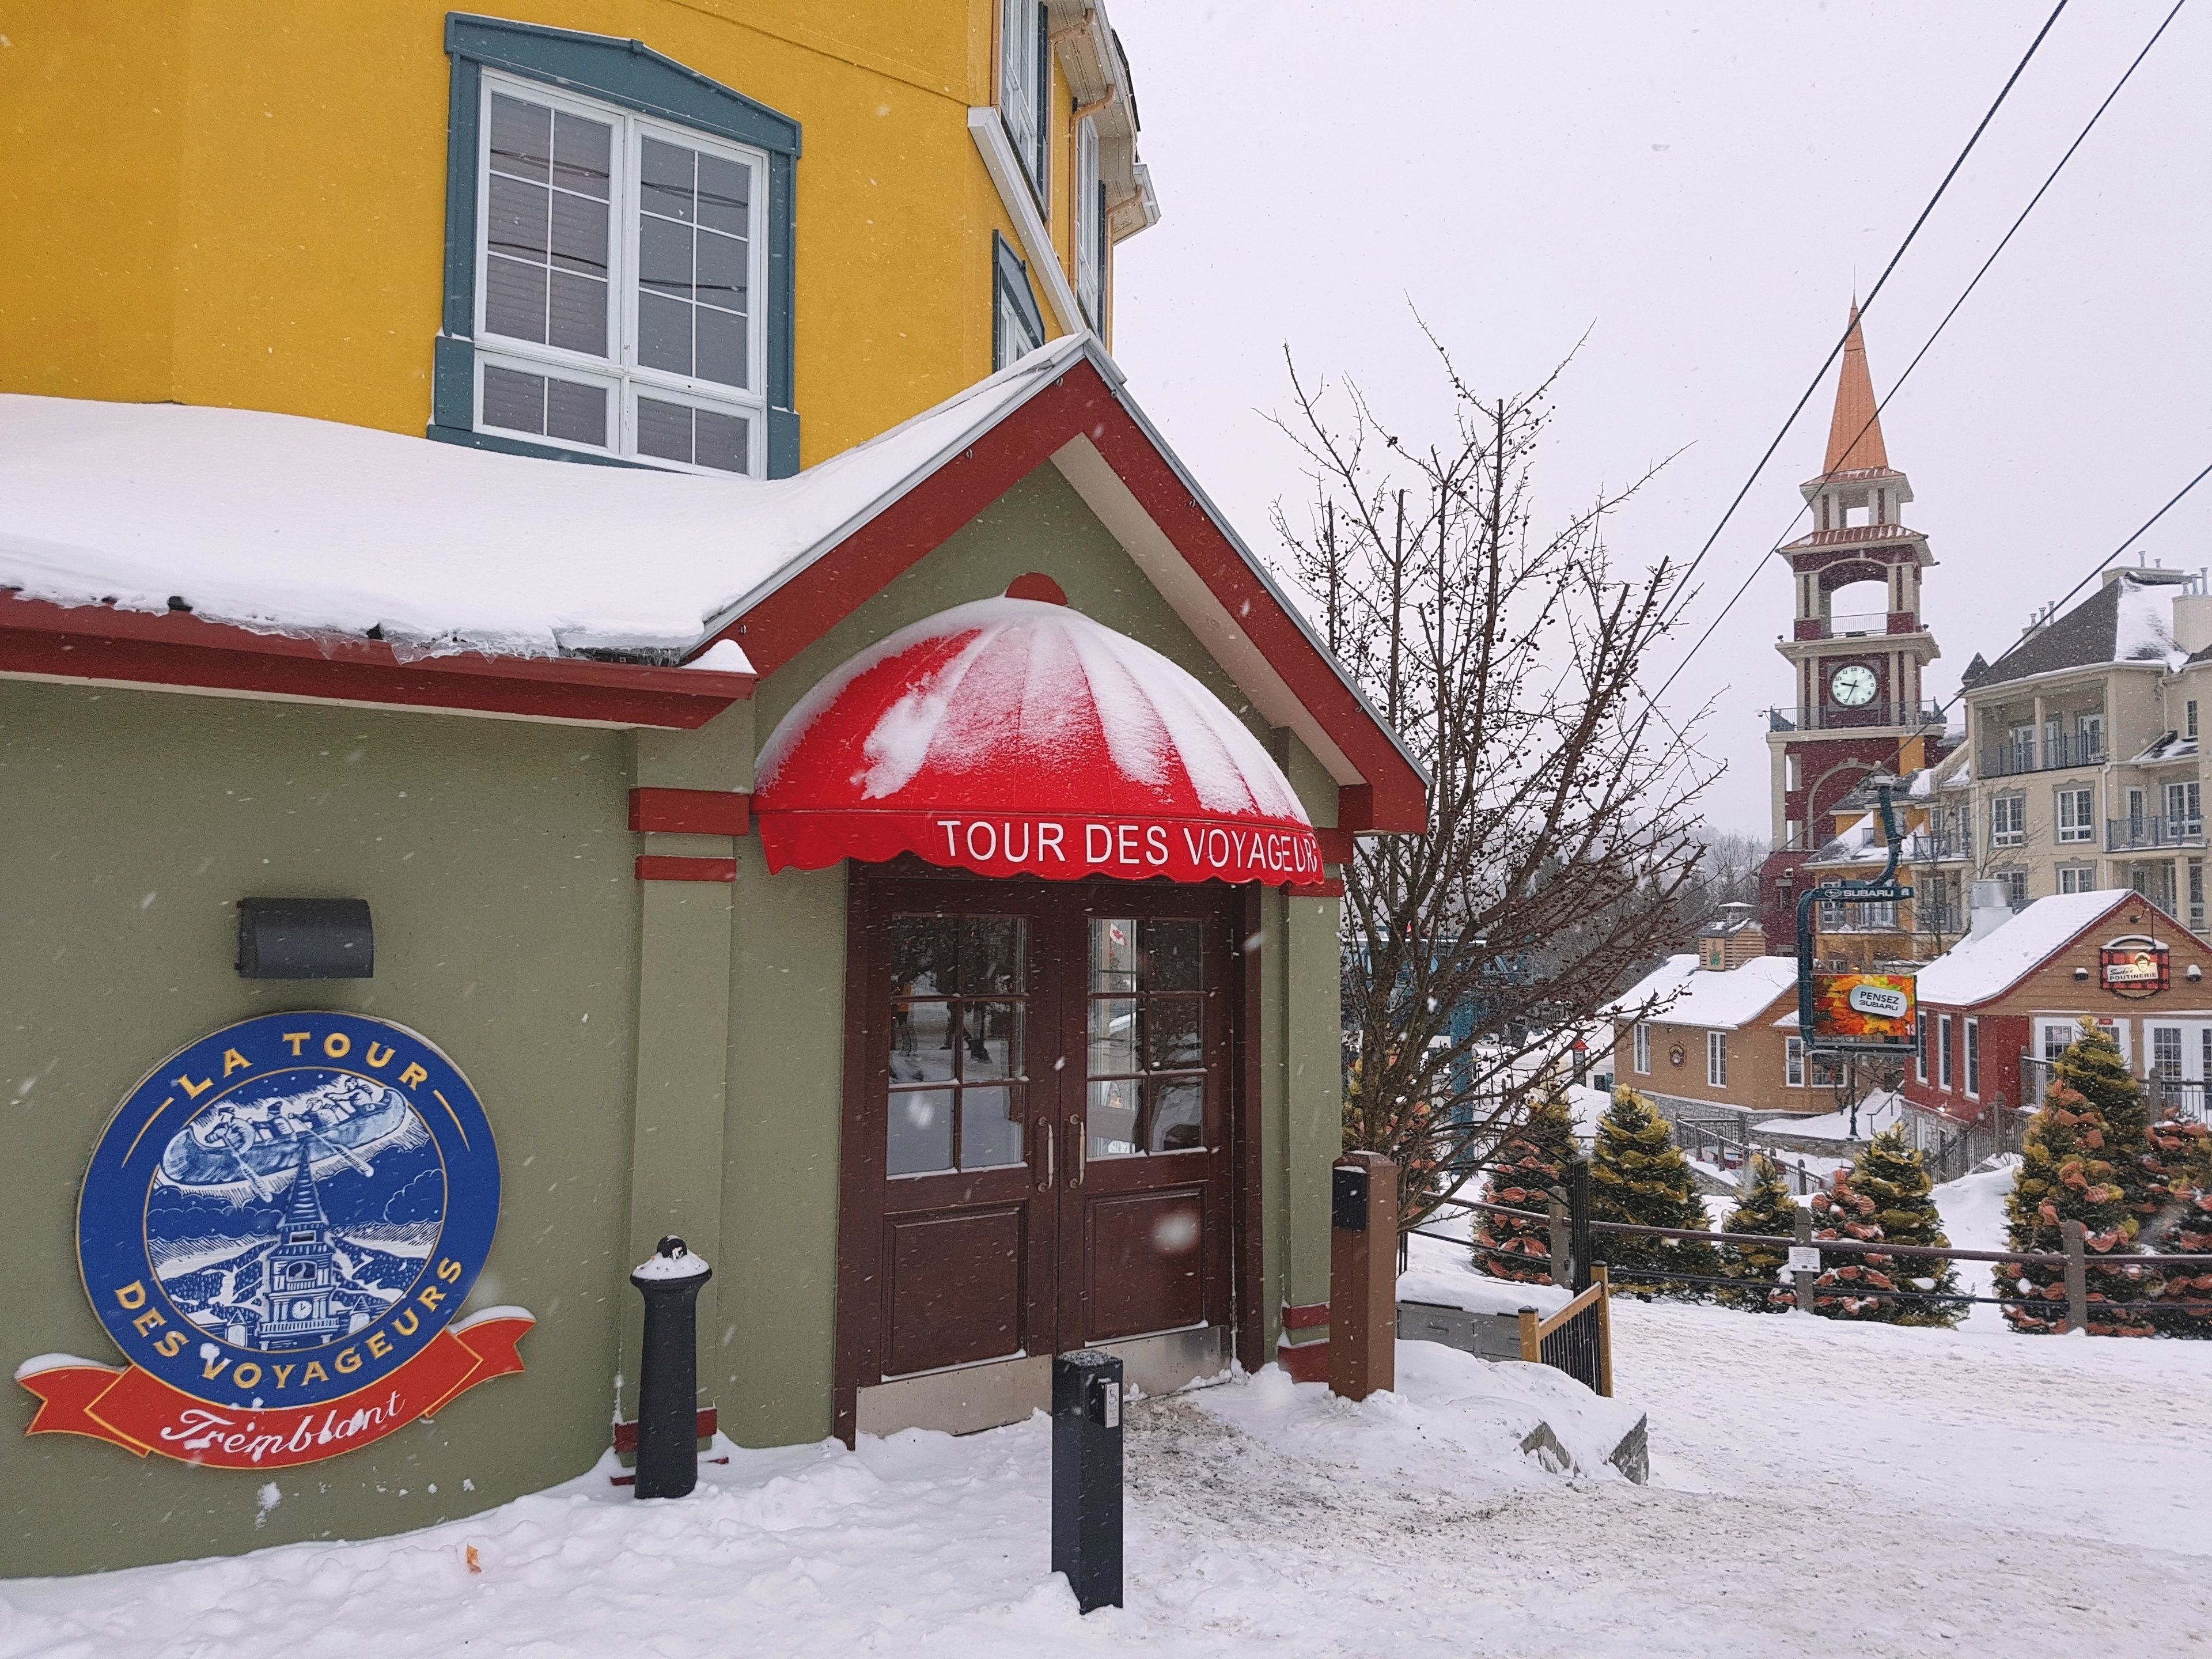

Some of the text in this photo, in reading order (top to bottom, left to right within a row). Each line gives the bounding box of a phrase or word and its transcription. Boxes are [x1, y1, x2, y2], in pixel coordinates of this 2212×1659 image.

[937, 820, 1066, 863] TOUR
[1086, 824, 1168, 865] DES
[1860, 991, 1900, 1004] PENSEZ
[2109, 972, 2157, 980] POUTINERIE
[1859, 999, 1898, 1011] SUBARU
[177, 1032, 429, 1100] LA TOUR
[116, 1257, 463, 1389] DES VOYAGEURS
[160, 1390, 406, 1453] Tremblant
